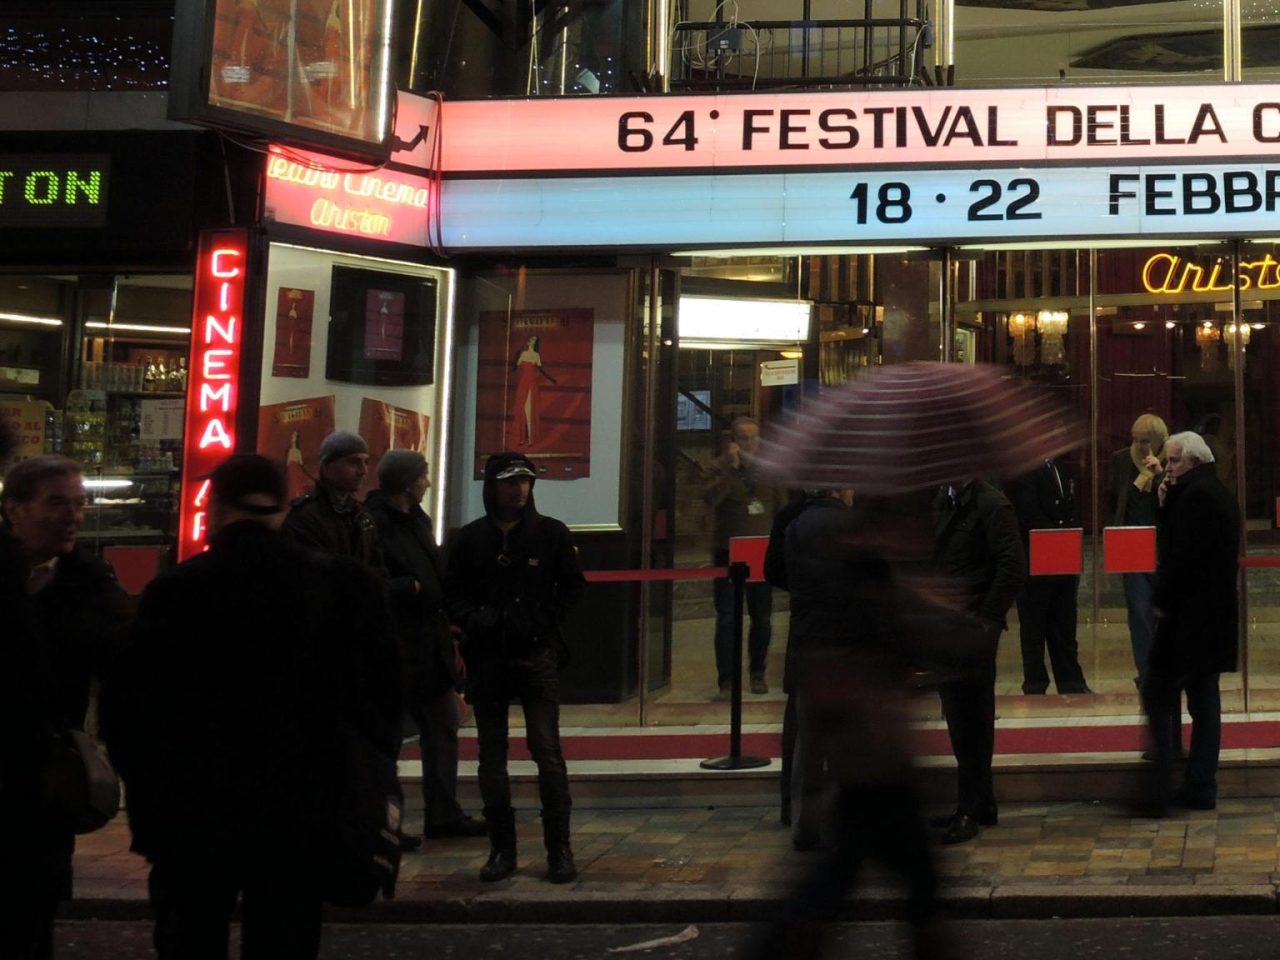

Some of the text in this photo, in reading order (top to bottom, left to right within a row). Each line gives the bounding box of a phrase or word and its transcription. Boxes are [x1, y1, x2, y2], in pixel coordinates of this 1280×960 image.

[742, 104, 1019, 151] FESTIVAL
[1047, 102, 1228, 147] DELLA
[849, 181, 912, 225] 18
[966, 177, 1043, 222] 22
[199, 249, 242, 449] CINEMA
